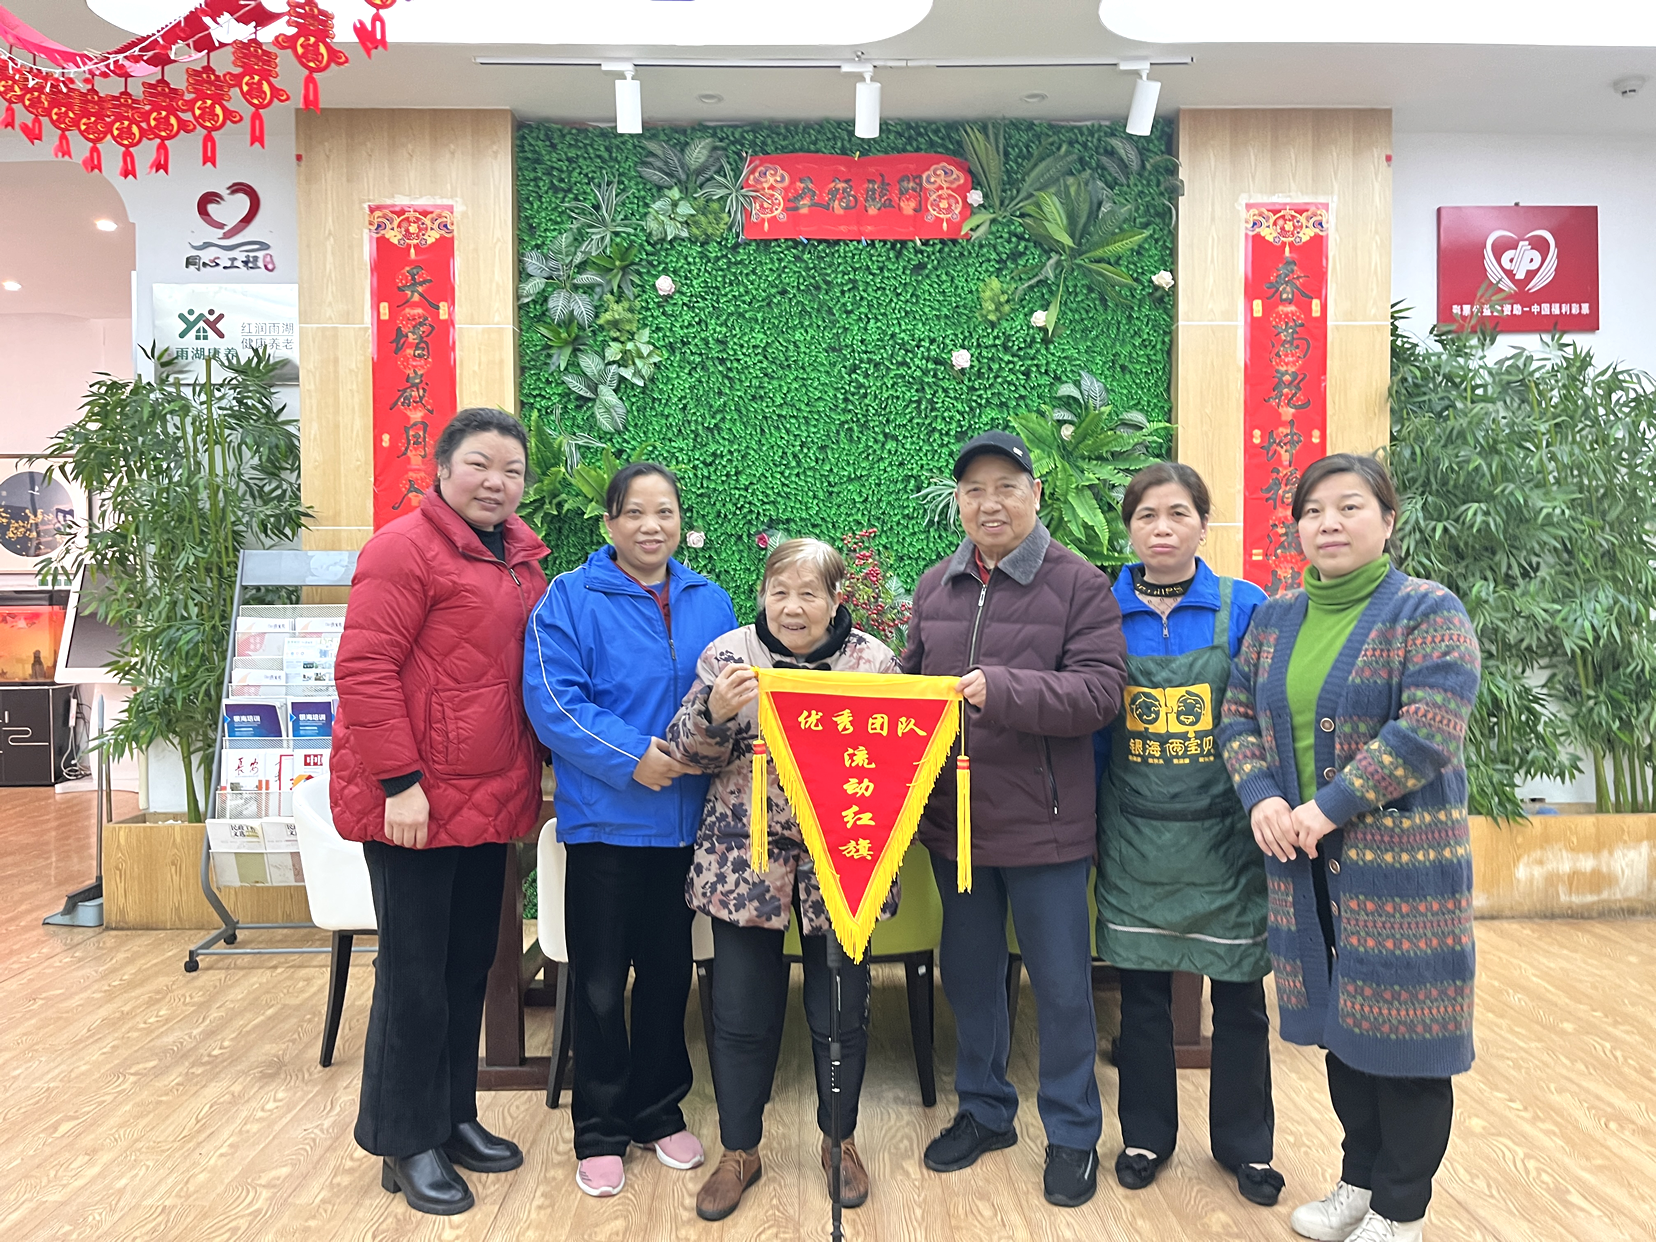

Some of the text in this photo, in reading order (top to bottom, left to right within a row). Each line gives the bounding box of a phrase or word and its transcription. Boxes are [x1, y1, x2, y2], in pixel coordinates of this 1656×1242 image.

[184, 254, 262, 272] 同心工程
[241, 322, 294, 335] 红润雨湖
[241, 337, 294, 351] 健康养老
[797, 708, 928, 738] 优秀团队
[1129, 735, 1216, 758] 银海俩宝贝
[838, 745, 876, 861] 流动红旗
